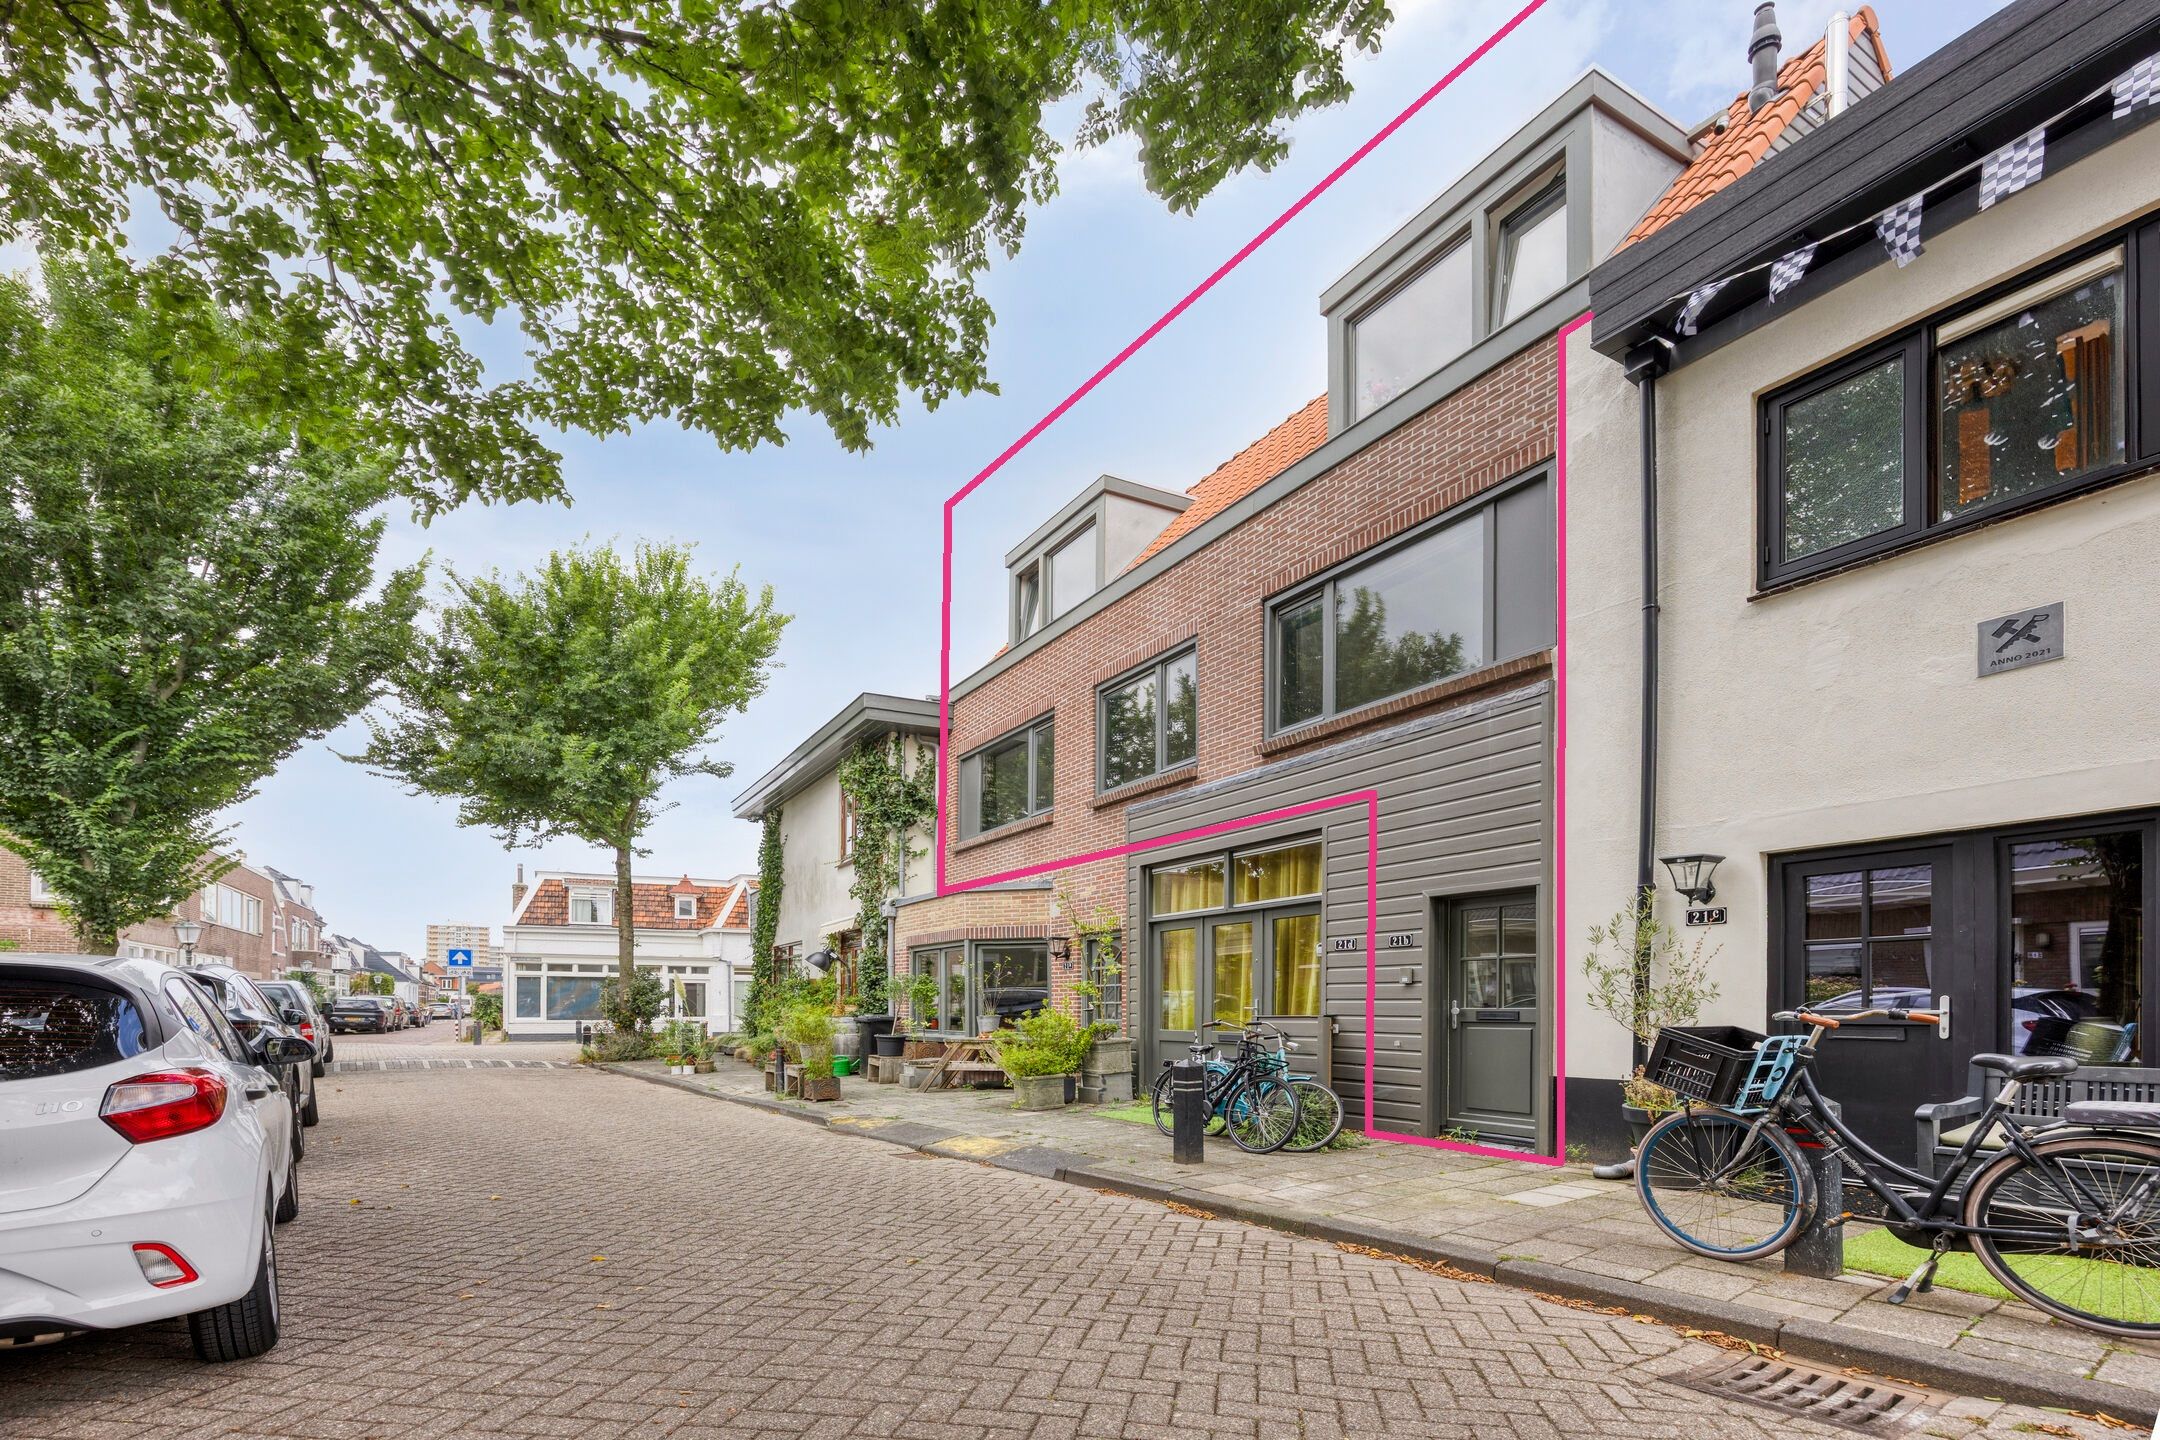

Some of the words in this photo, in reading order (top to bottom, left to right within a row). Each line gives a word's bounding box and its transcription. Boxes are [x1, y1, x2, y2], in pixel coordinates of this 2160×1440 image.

[1990, 654, 2022, 667] ANNO
[2025, 647, 2051, 659] 2021
[1692, 910, 1719, 923] 21c
